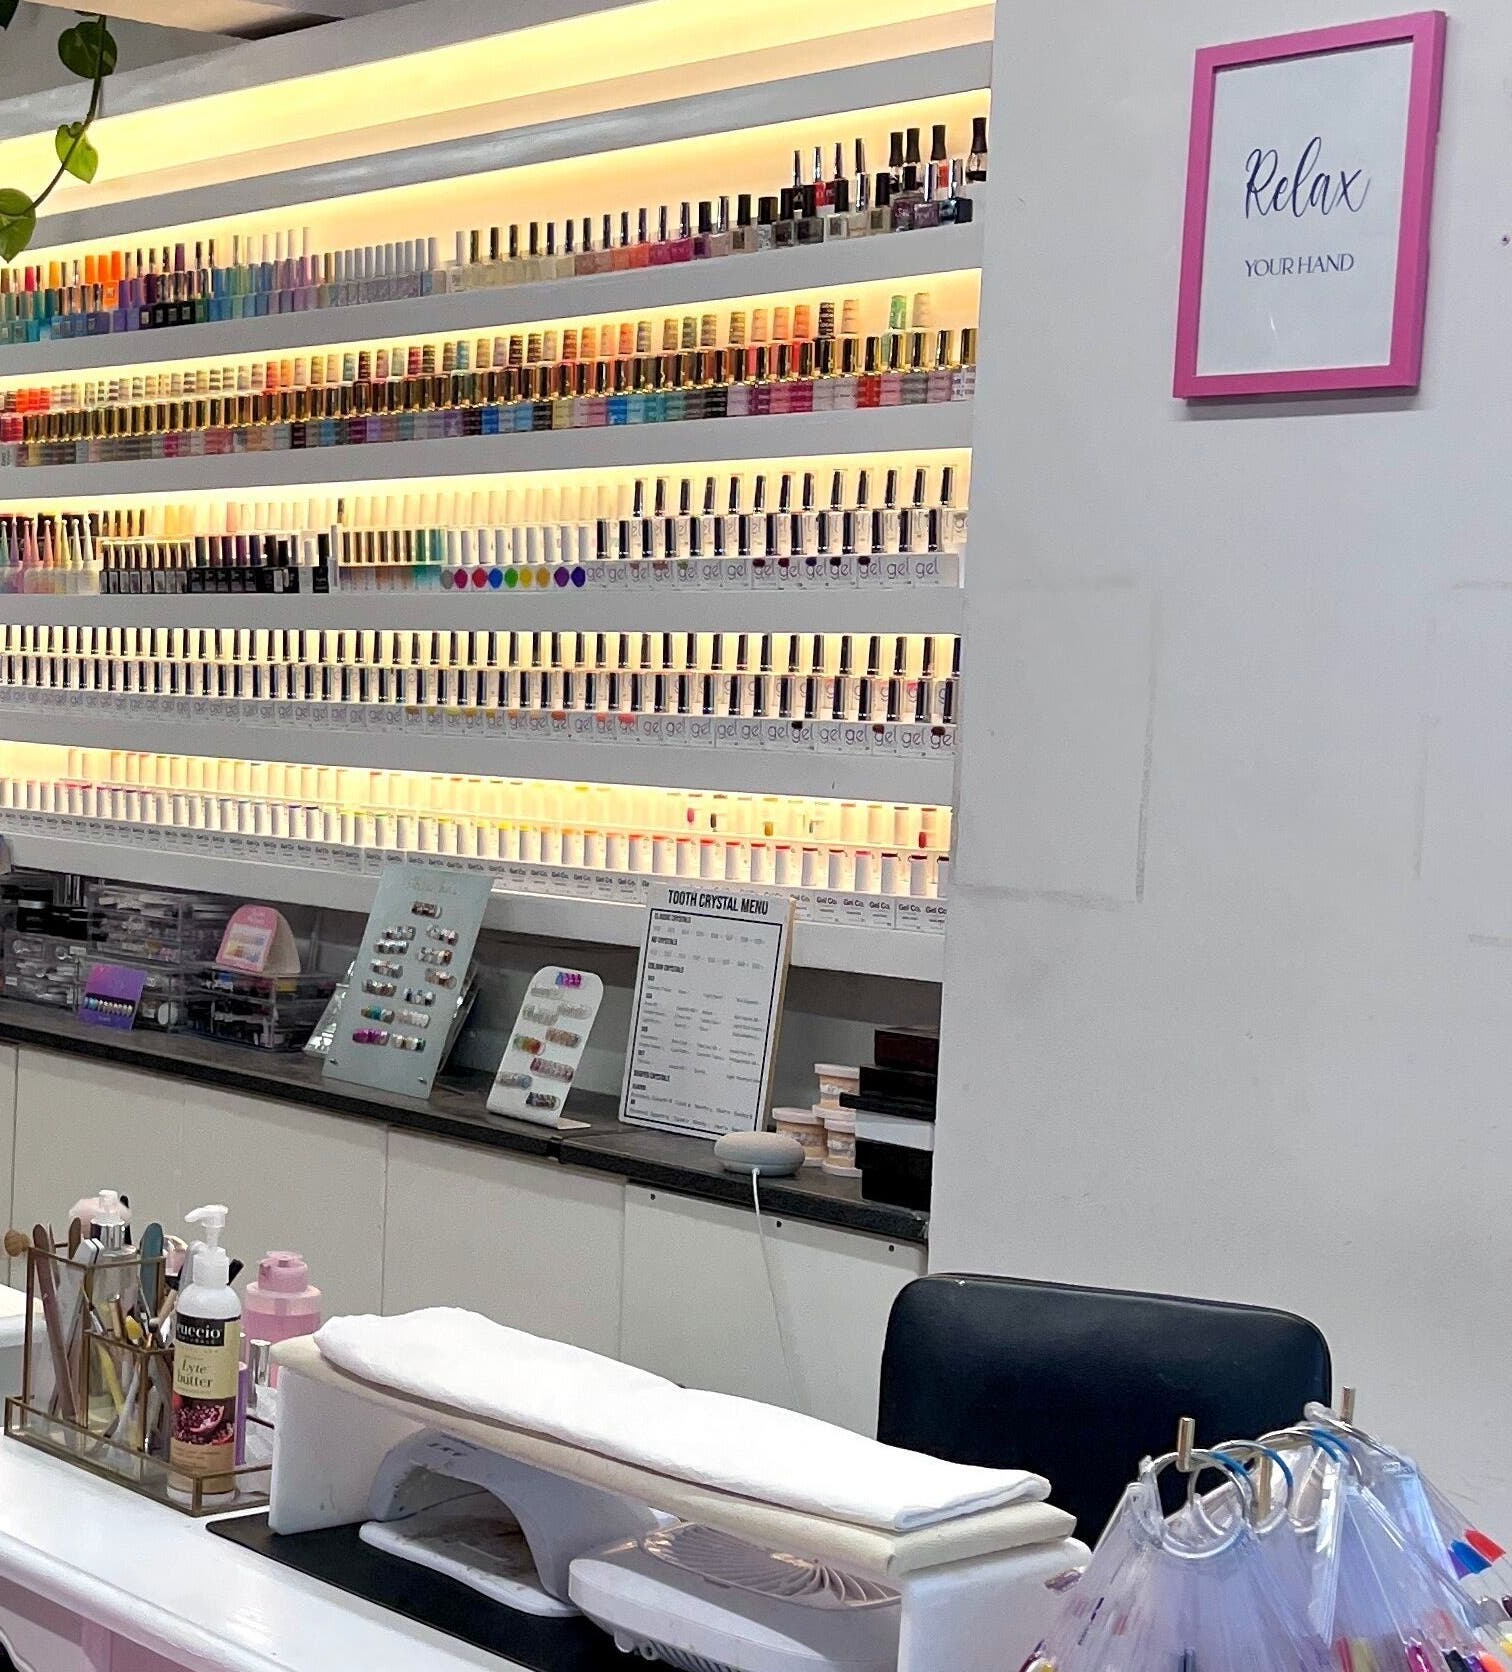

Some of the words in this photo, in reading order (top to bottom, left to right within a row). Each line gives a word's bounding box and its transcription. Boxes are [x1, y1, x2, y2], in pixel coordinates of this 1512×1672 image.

[1244, 136, 1371, 219] Relax
[1245, 257, 1294, 277] YOUR
[1297, 253, 1354, 274] HAND
[727, 559, 748, 580] gel
[806, 557, 827, 580] gel
[830, 557, 853, 580] gel
[859, 556, 882, 579] gel
[887, 557, 910, 579] gel
[915, 556, 939, 579] gel
[691, 717, 712, 738] gel
[717, 719, 737, 739] gel
[741, 720, 763, 740] gel
[767, 720, 789, 741] gel
[791, 723, 814, 743] gel
[819, 723, 842, 744] gel
[845, 723, 868, 745] gel
[874, 725, 897, 746] gel
[902, 727, 926, 748] gel
[930, 727, 957, 749] gel
[668, 889, 697, 907] TOOTH
[698, 893, 739, 912] CRYSTAL
[740, 898, 769, 916] MENU
[925, 906, 937, 914] Gel
[177, 1369, 212, 1388] butter
